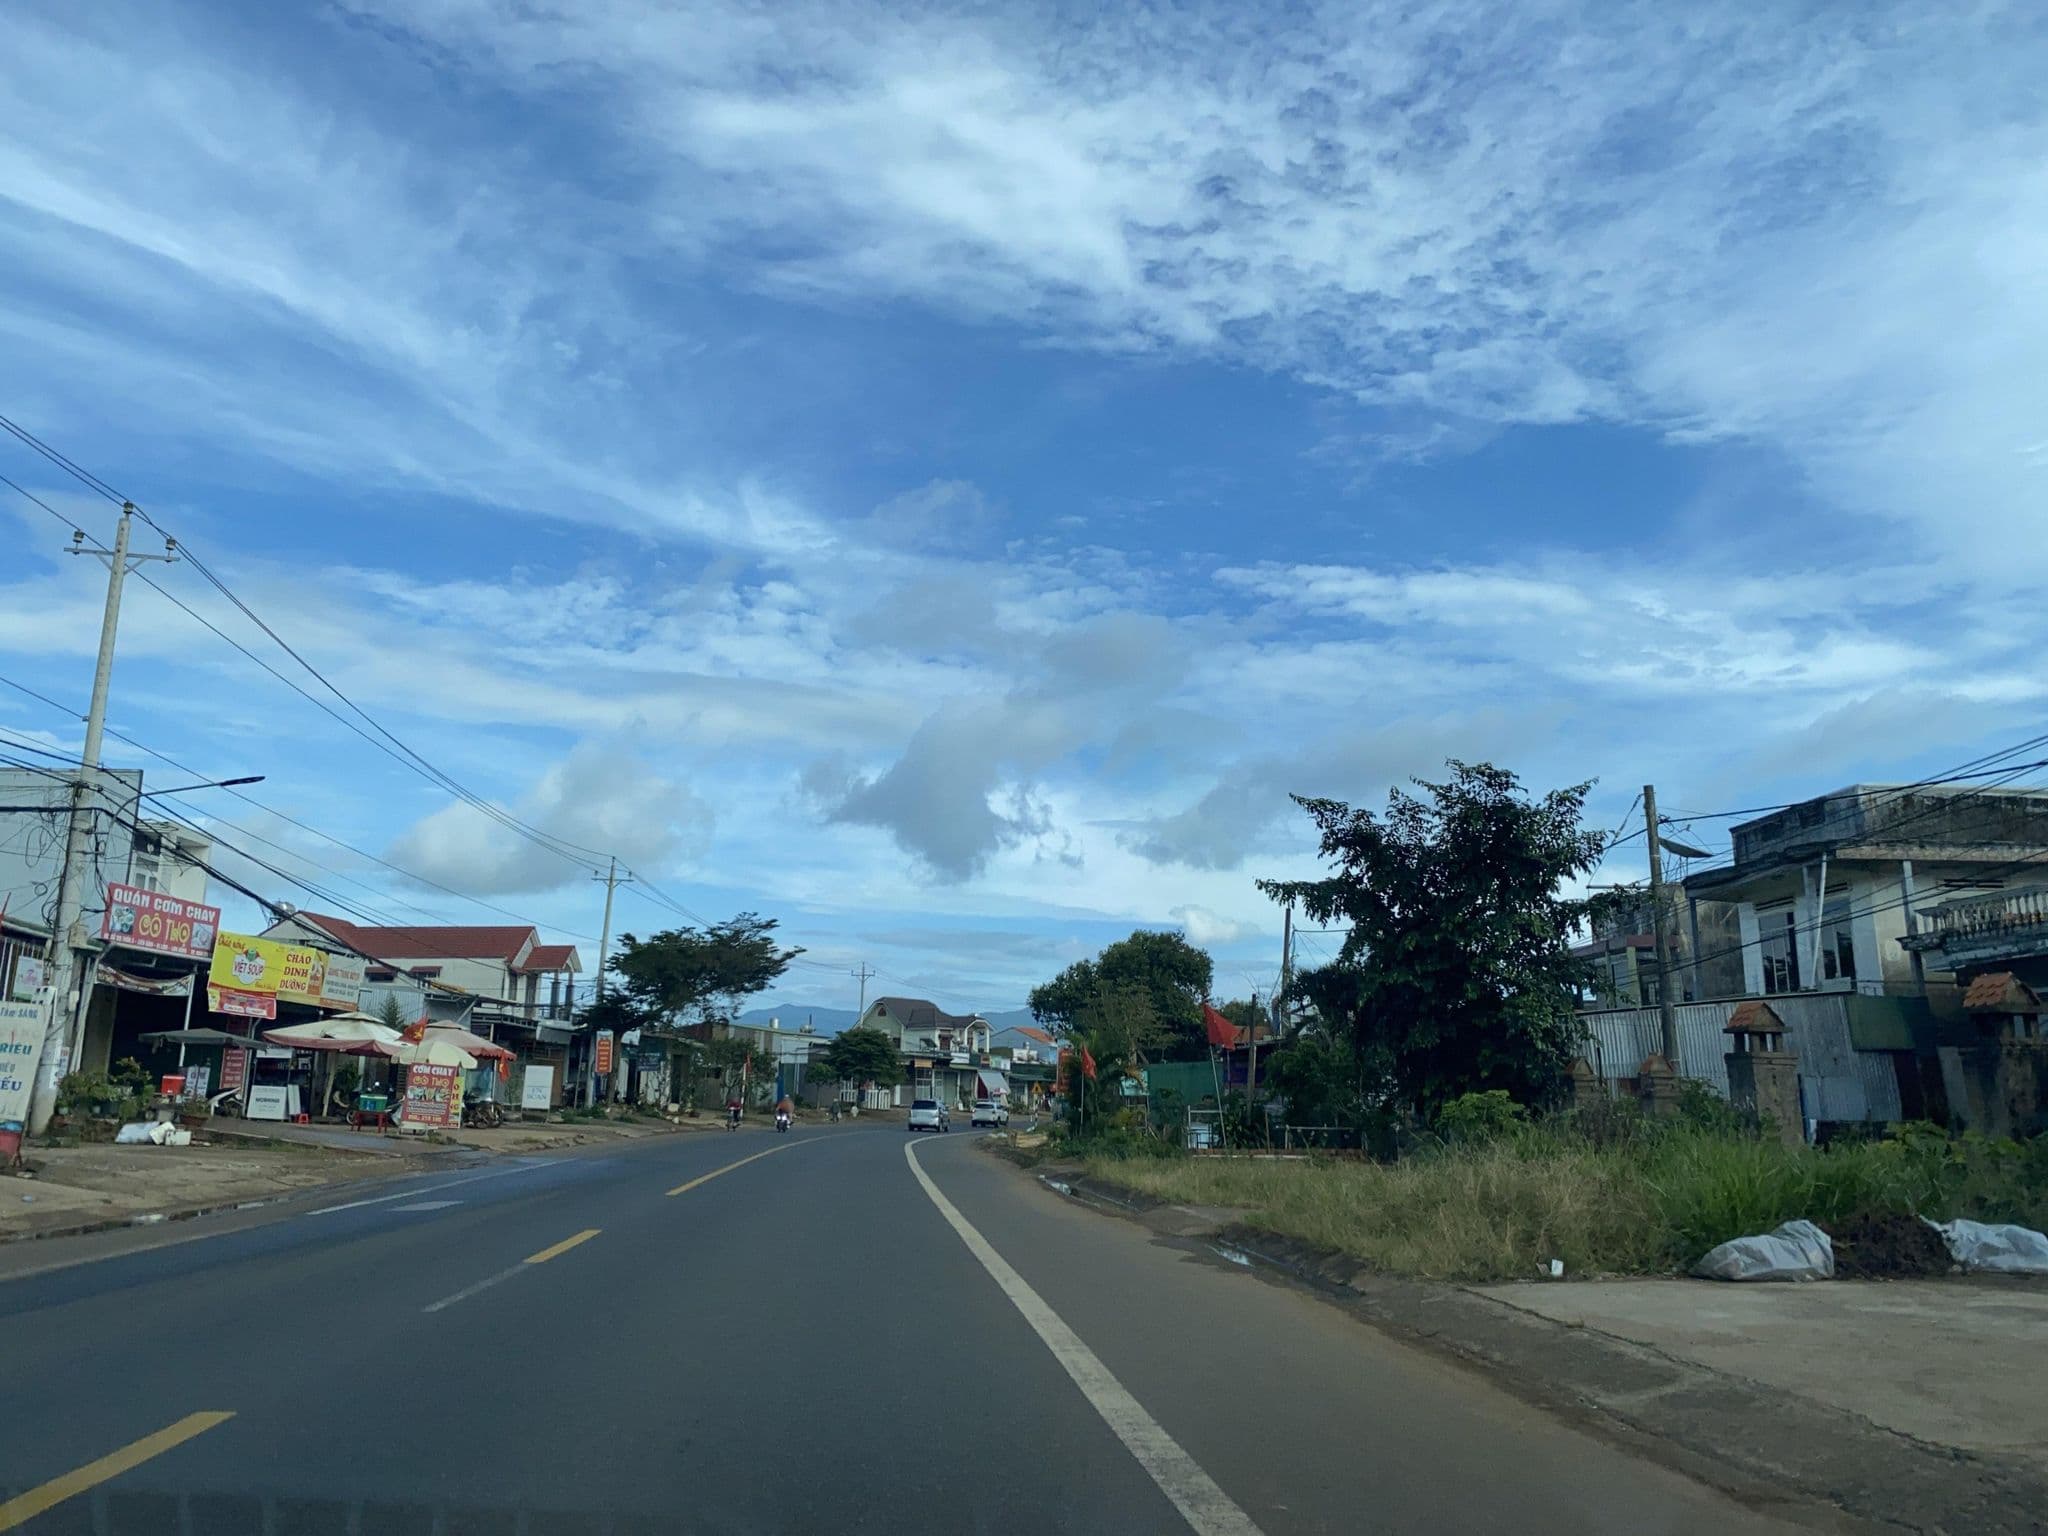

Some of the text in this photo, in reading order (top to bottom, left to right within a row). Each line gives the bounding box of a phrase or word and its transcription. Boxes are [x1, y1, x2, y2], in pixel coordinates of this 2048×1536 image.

[114, 888, 216, 922] QUÁN CƠM CHAY
[139, 913, 162, 938] CÔ
[284, 966, 309, 978] DINH
